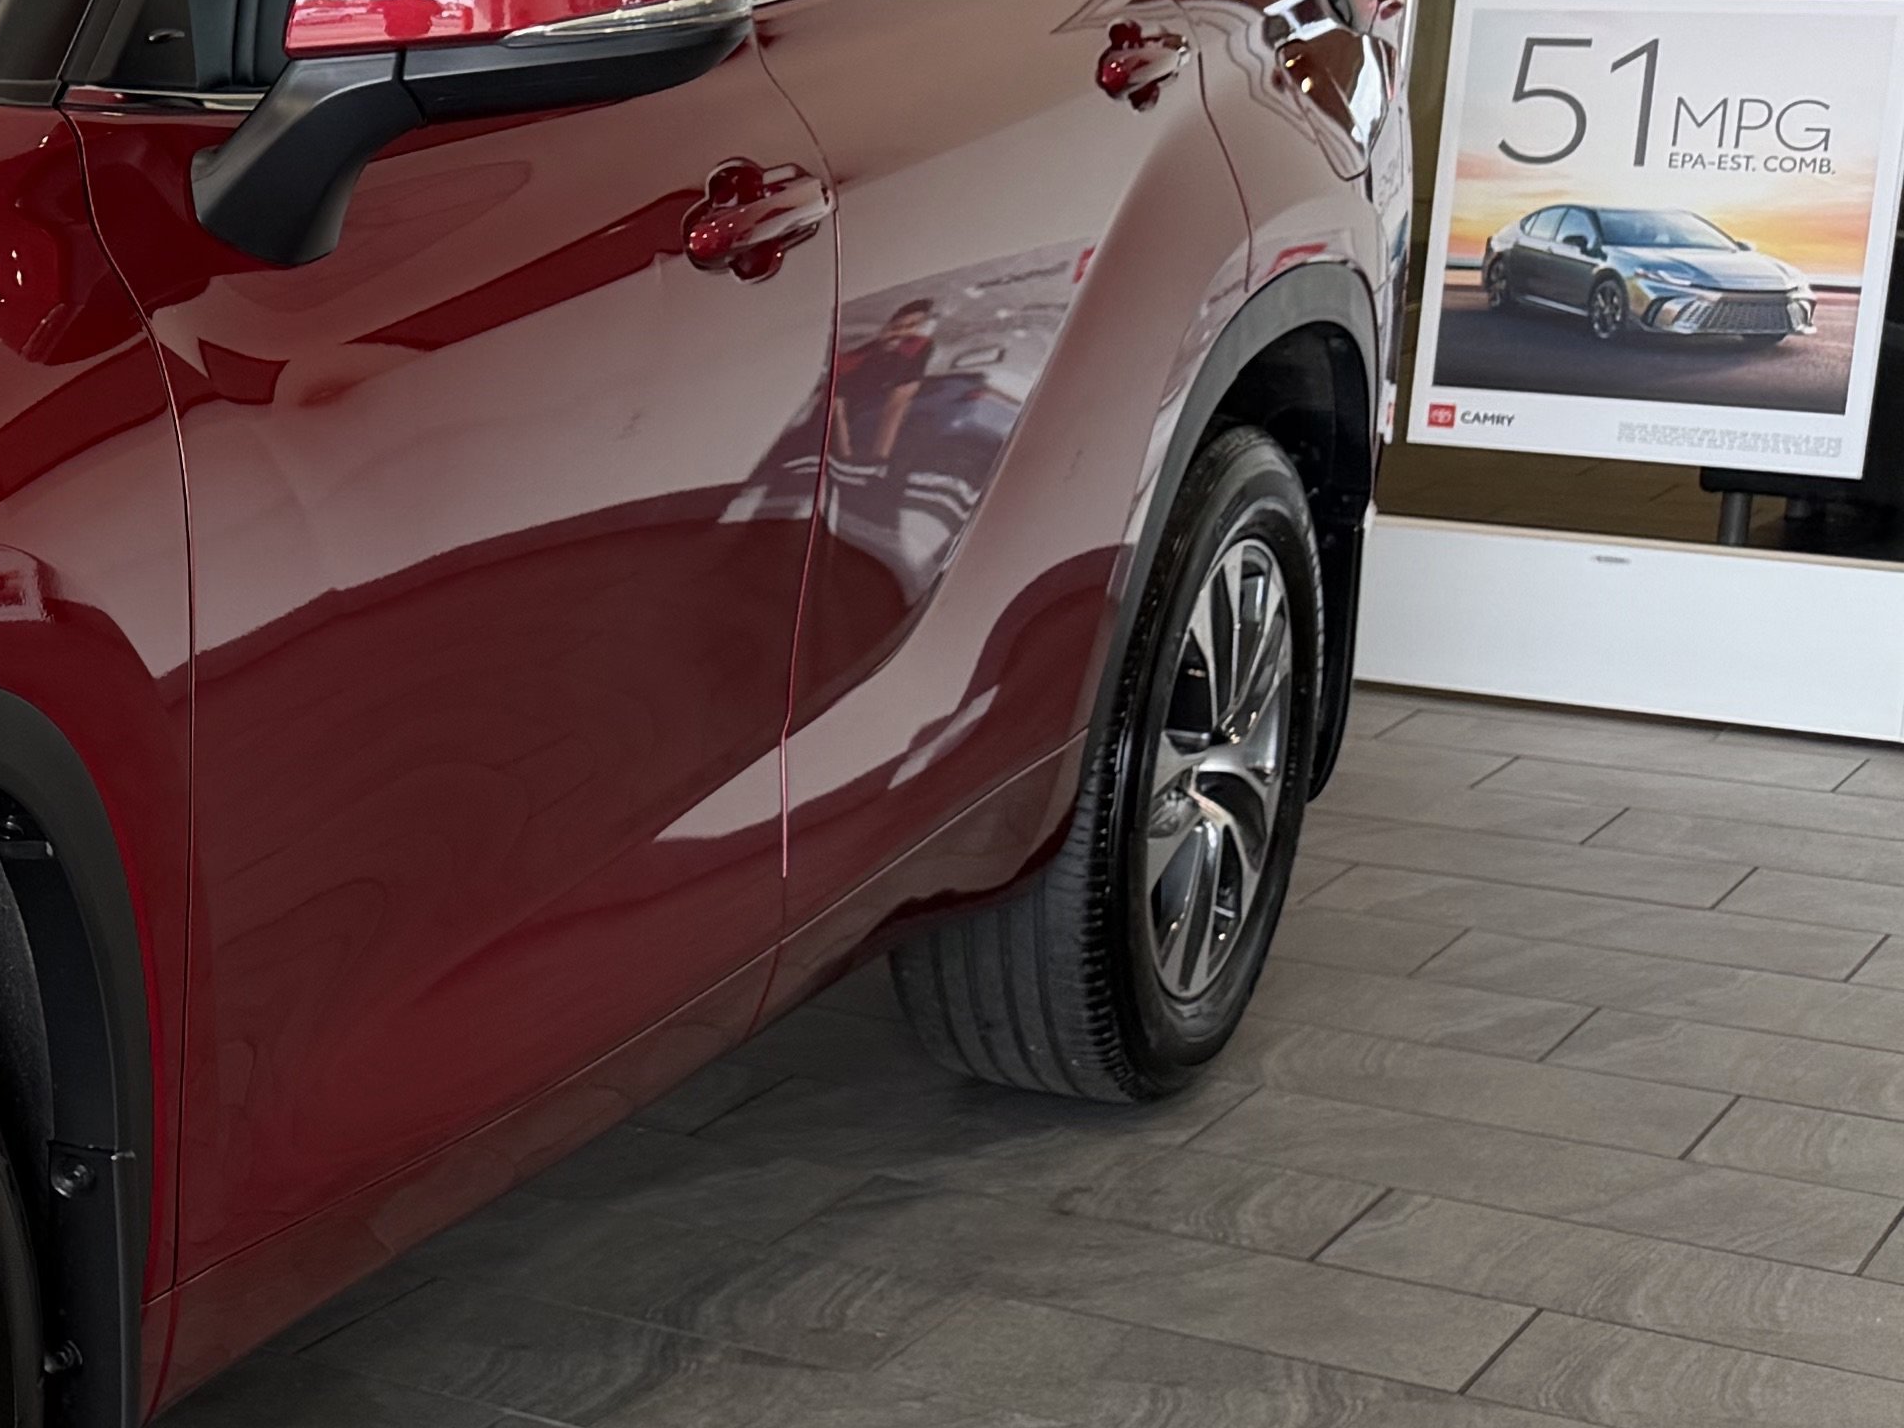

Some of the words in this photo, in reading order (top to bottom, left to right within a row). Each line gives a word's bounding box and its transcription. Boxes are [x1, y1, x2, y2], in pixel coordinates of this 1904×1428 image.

[1497, 36, 1659, 167] 51
[1672, 96, 1830, 152] MPG
[1668, 152, 1756, 173] EPA-EST.
[1763, 155, 1836, 176] COMB.
[1460, 410, 1515, 427] CAMRY
